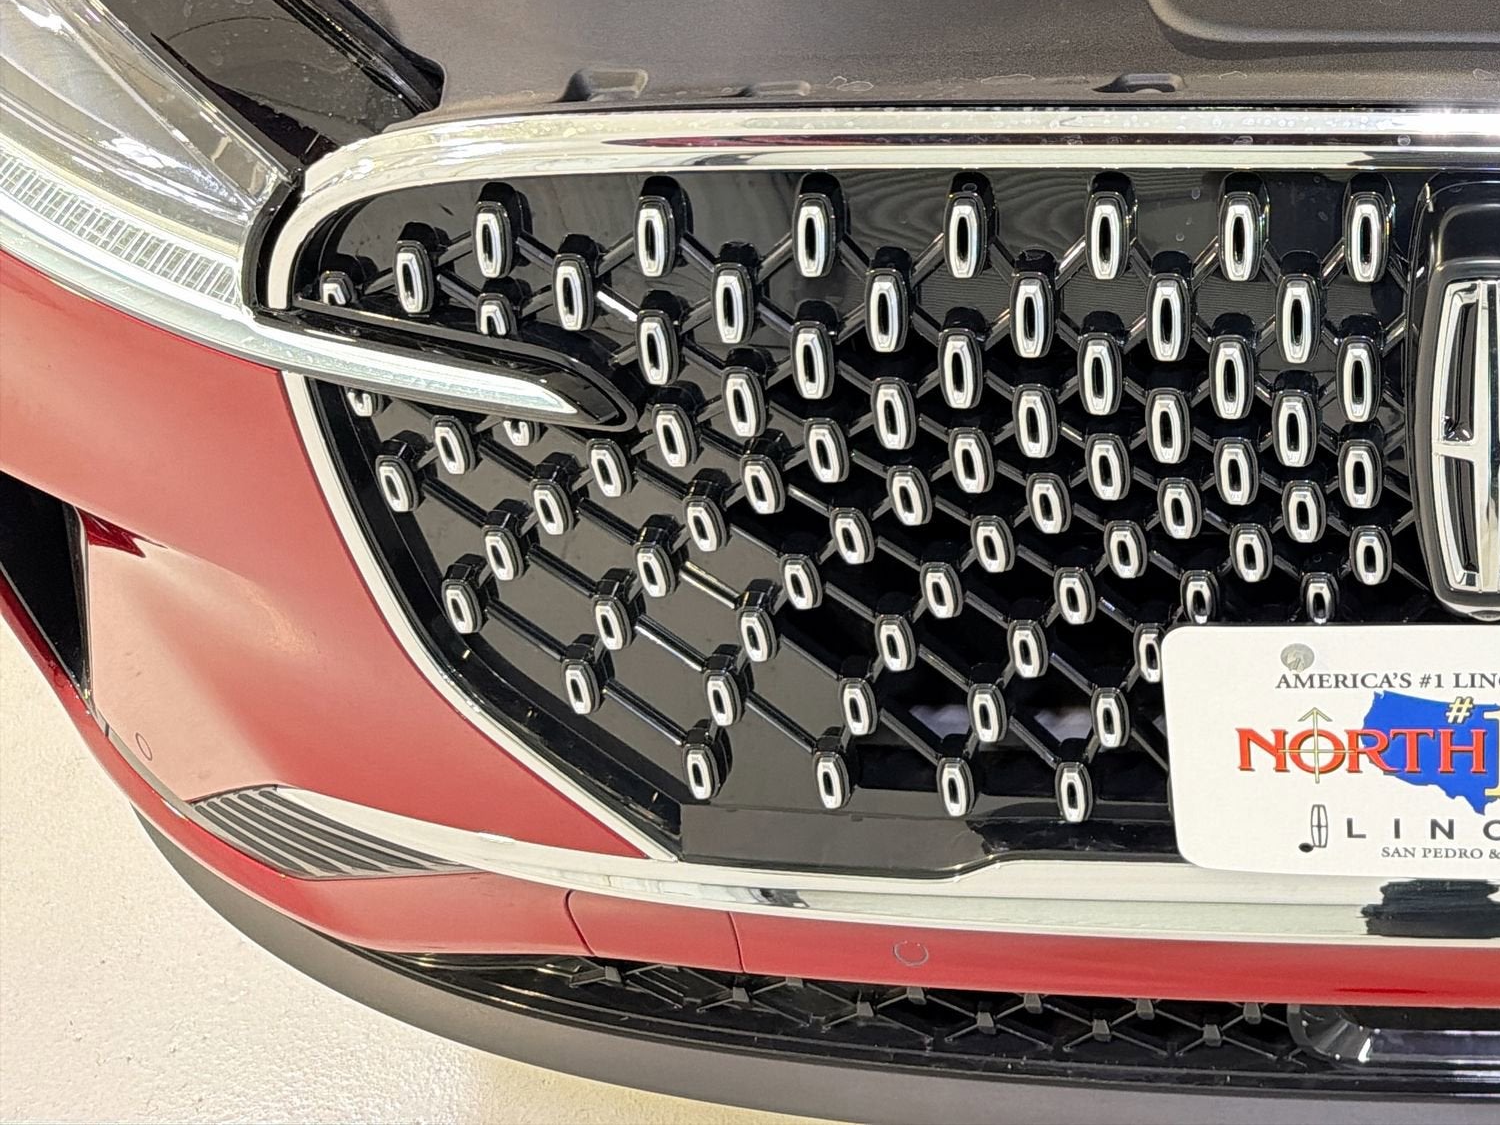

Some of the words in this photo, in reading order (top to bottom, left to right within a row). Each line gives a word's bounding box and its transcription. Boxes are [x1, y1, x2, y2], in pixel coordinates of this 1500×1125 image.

[1275, 672, 1413, 690] AMERICA'S
[1418, 672, 1445, 689] #1
[1235, 727, 1488, 774] NORTH
[1380, 846, 1417, 859] SAN
[1421, 848, 1484, 860] PEDRO
